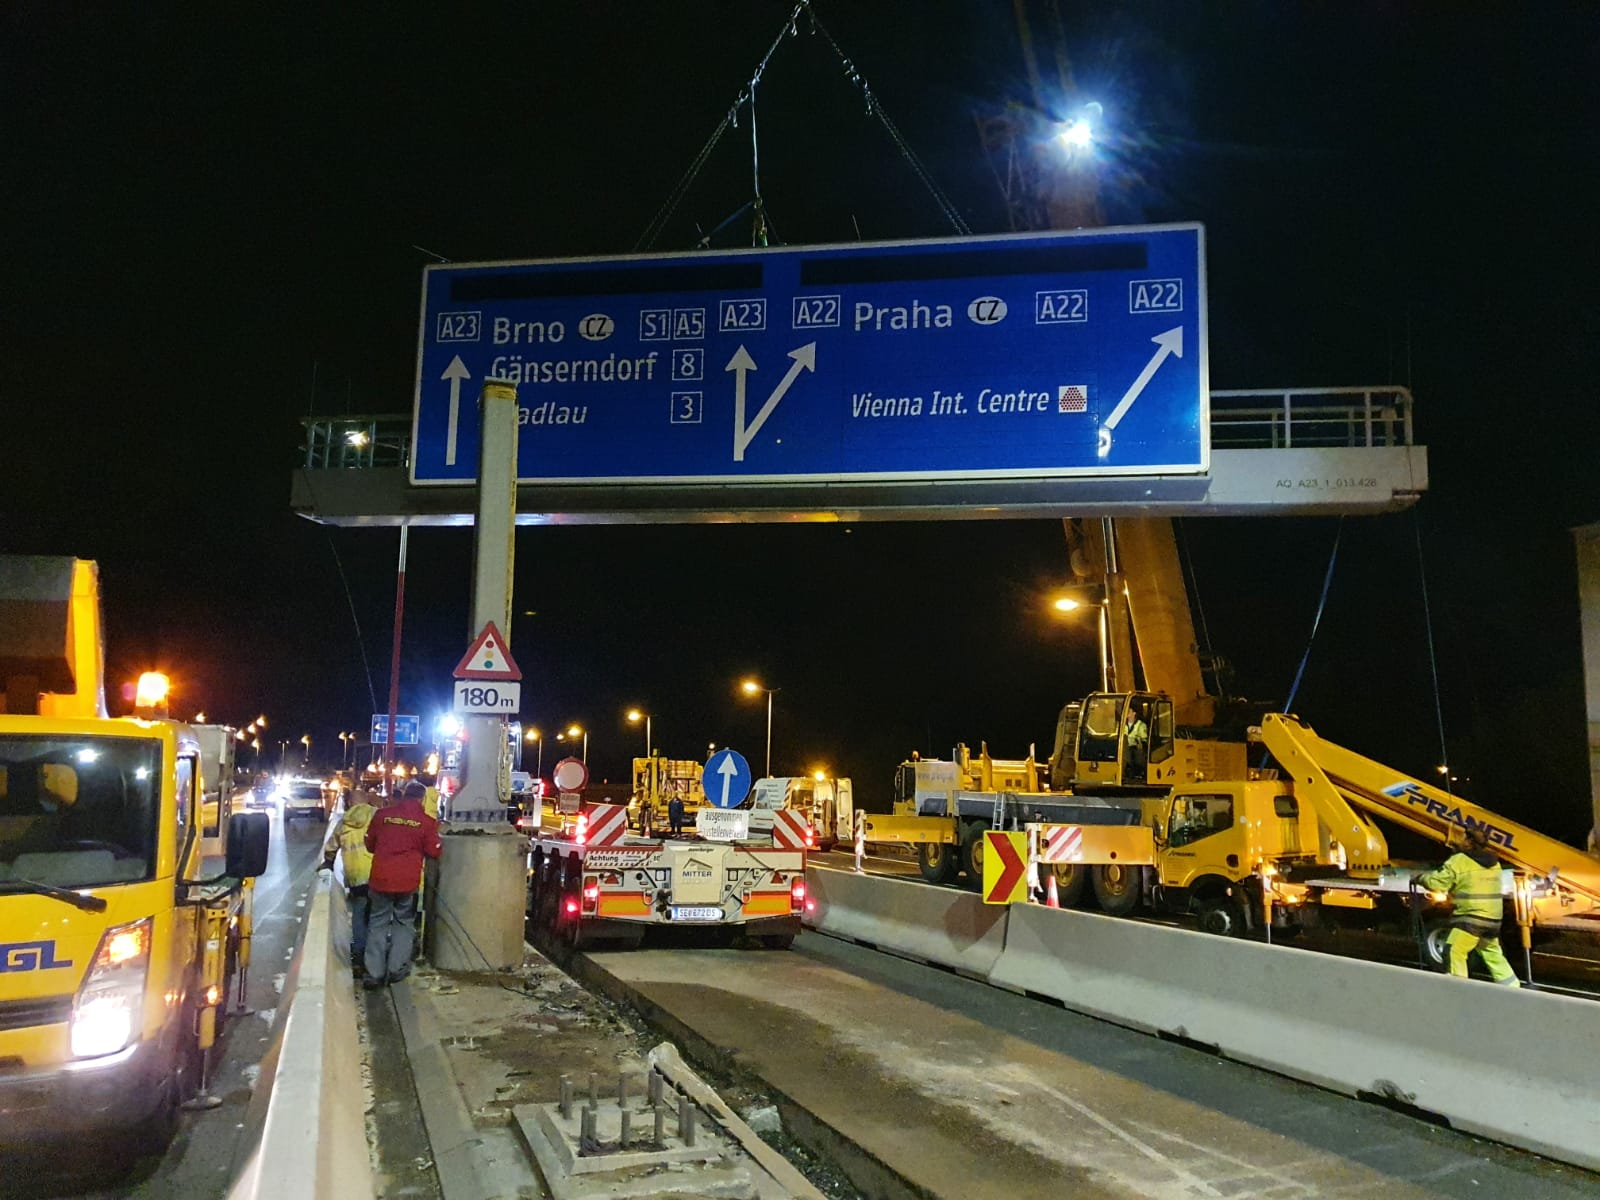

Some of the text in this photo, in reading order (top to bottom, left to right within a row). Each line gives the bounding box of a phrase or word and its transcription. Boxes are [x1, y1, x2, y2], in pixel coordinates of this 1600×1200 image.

[1135, 283, 1178, 308] A22
[724, 304, 762, 326] A23
[797, 301, 835, 324] A22
[854, 300, 999, 331] Praha CZ
[1041, 295, 1083, 319] A22
[441, 316, 476, 338] A23
[493, 317, 608, 344] Brno CZ
[645, 314, 667, 336] S1
[676, 313, 702, 335] A5
[491, 352, 658, 384] Gänserndorf
[683, 354, 694, 375] 8
[518, 401, 587, 425] adlau
[682, 397, 693, 418] 3
[852, 388, 1049, 418] Vienna Int. Centre
[460, 688, 514, 707] 180 m
[589, 854, 619, 862] Achtung
